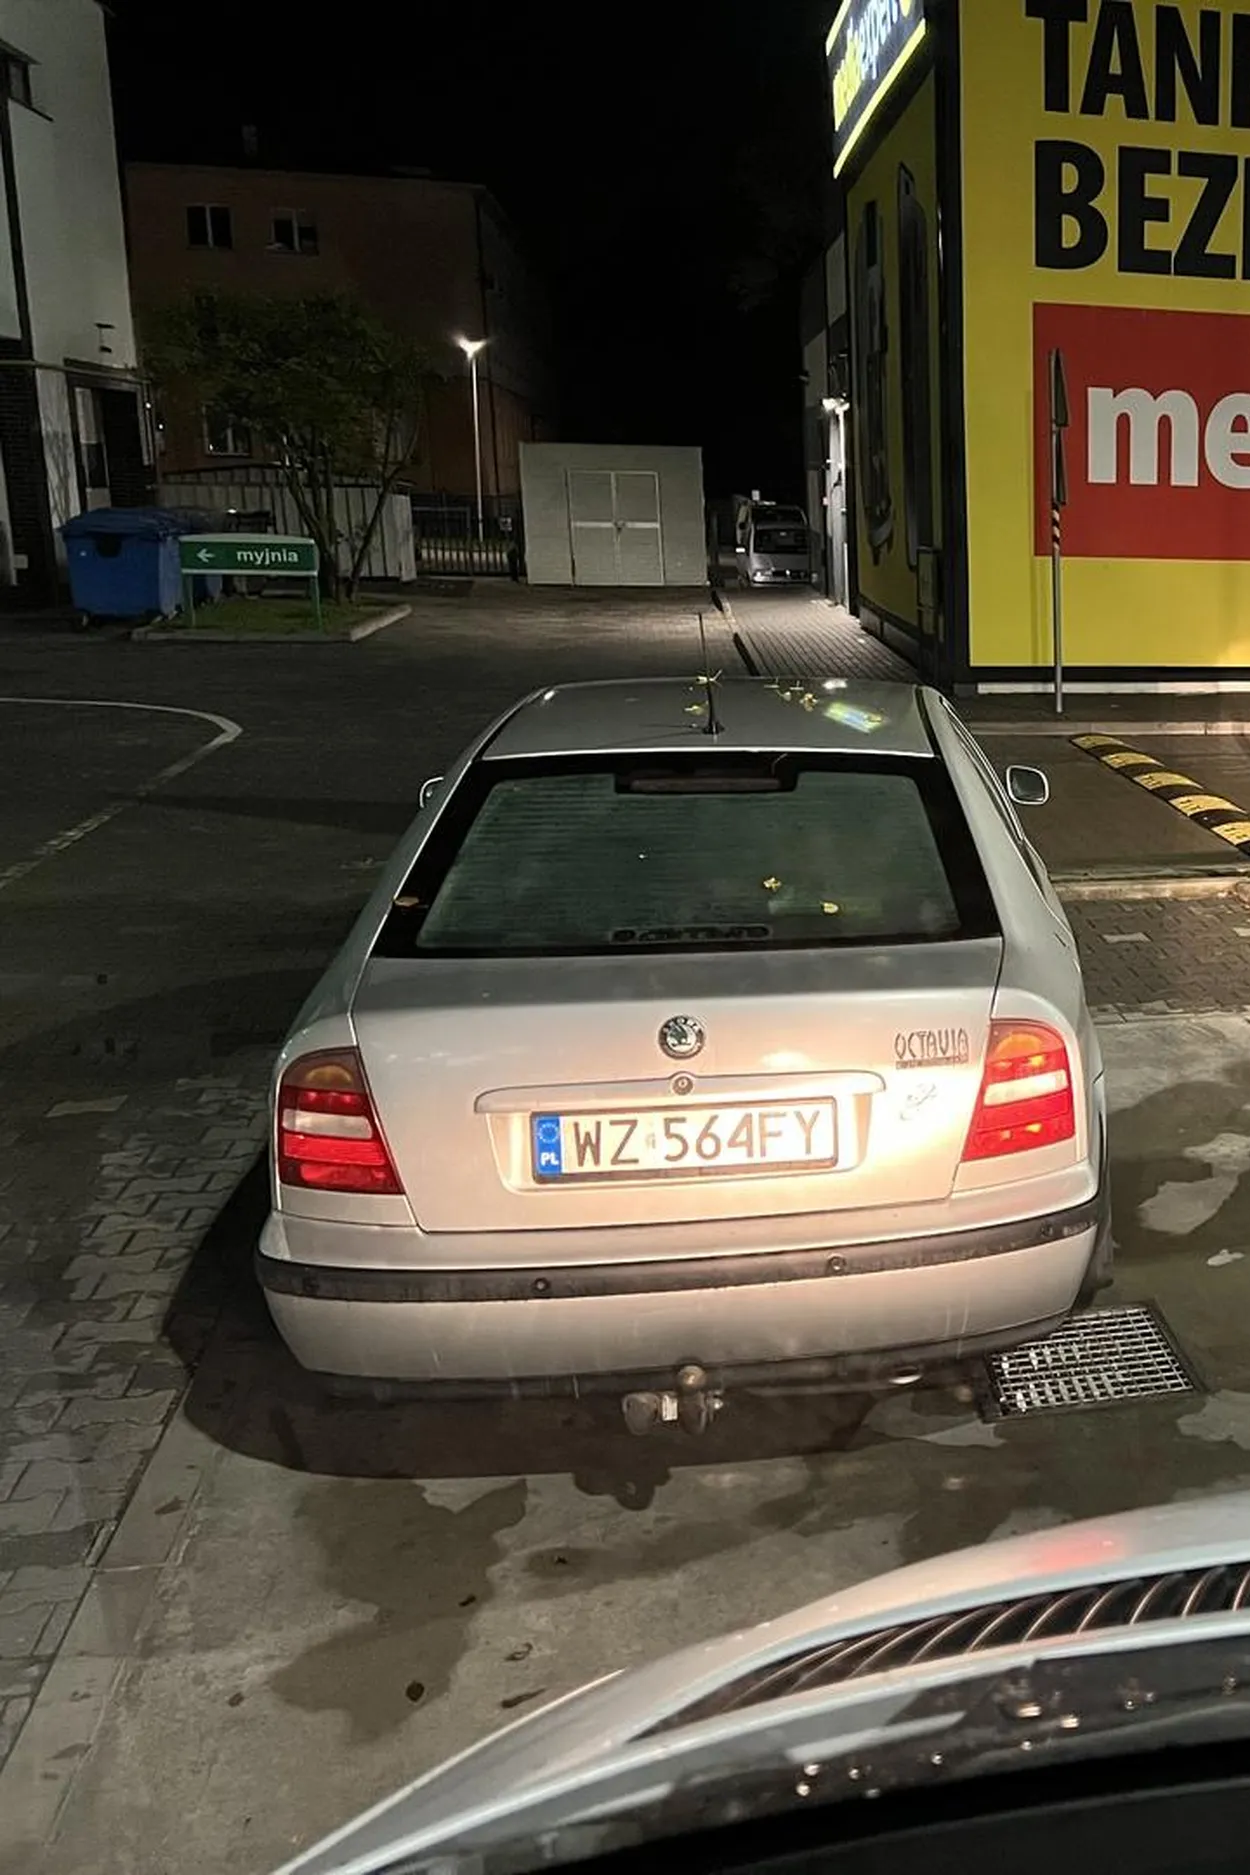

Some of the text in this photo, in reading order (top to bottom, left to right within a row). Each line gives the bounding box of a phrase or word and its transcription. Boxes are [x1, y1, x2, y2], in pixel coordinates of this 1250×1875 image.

[236, 548, 299, 565] myjnia
[894, 1028, 969, 1059] OCTAVIA
[573, 1110, 820, 1167] WZ 564FY
[540, 1151, 560, 1166] PL
